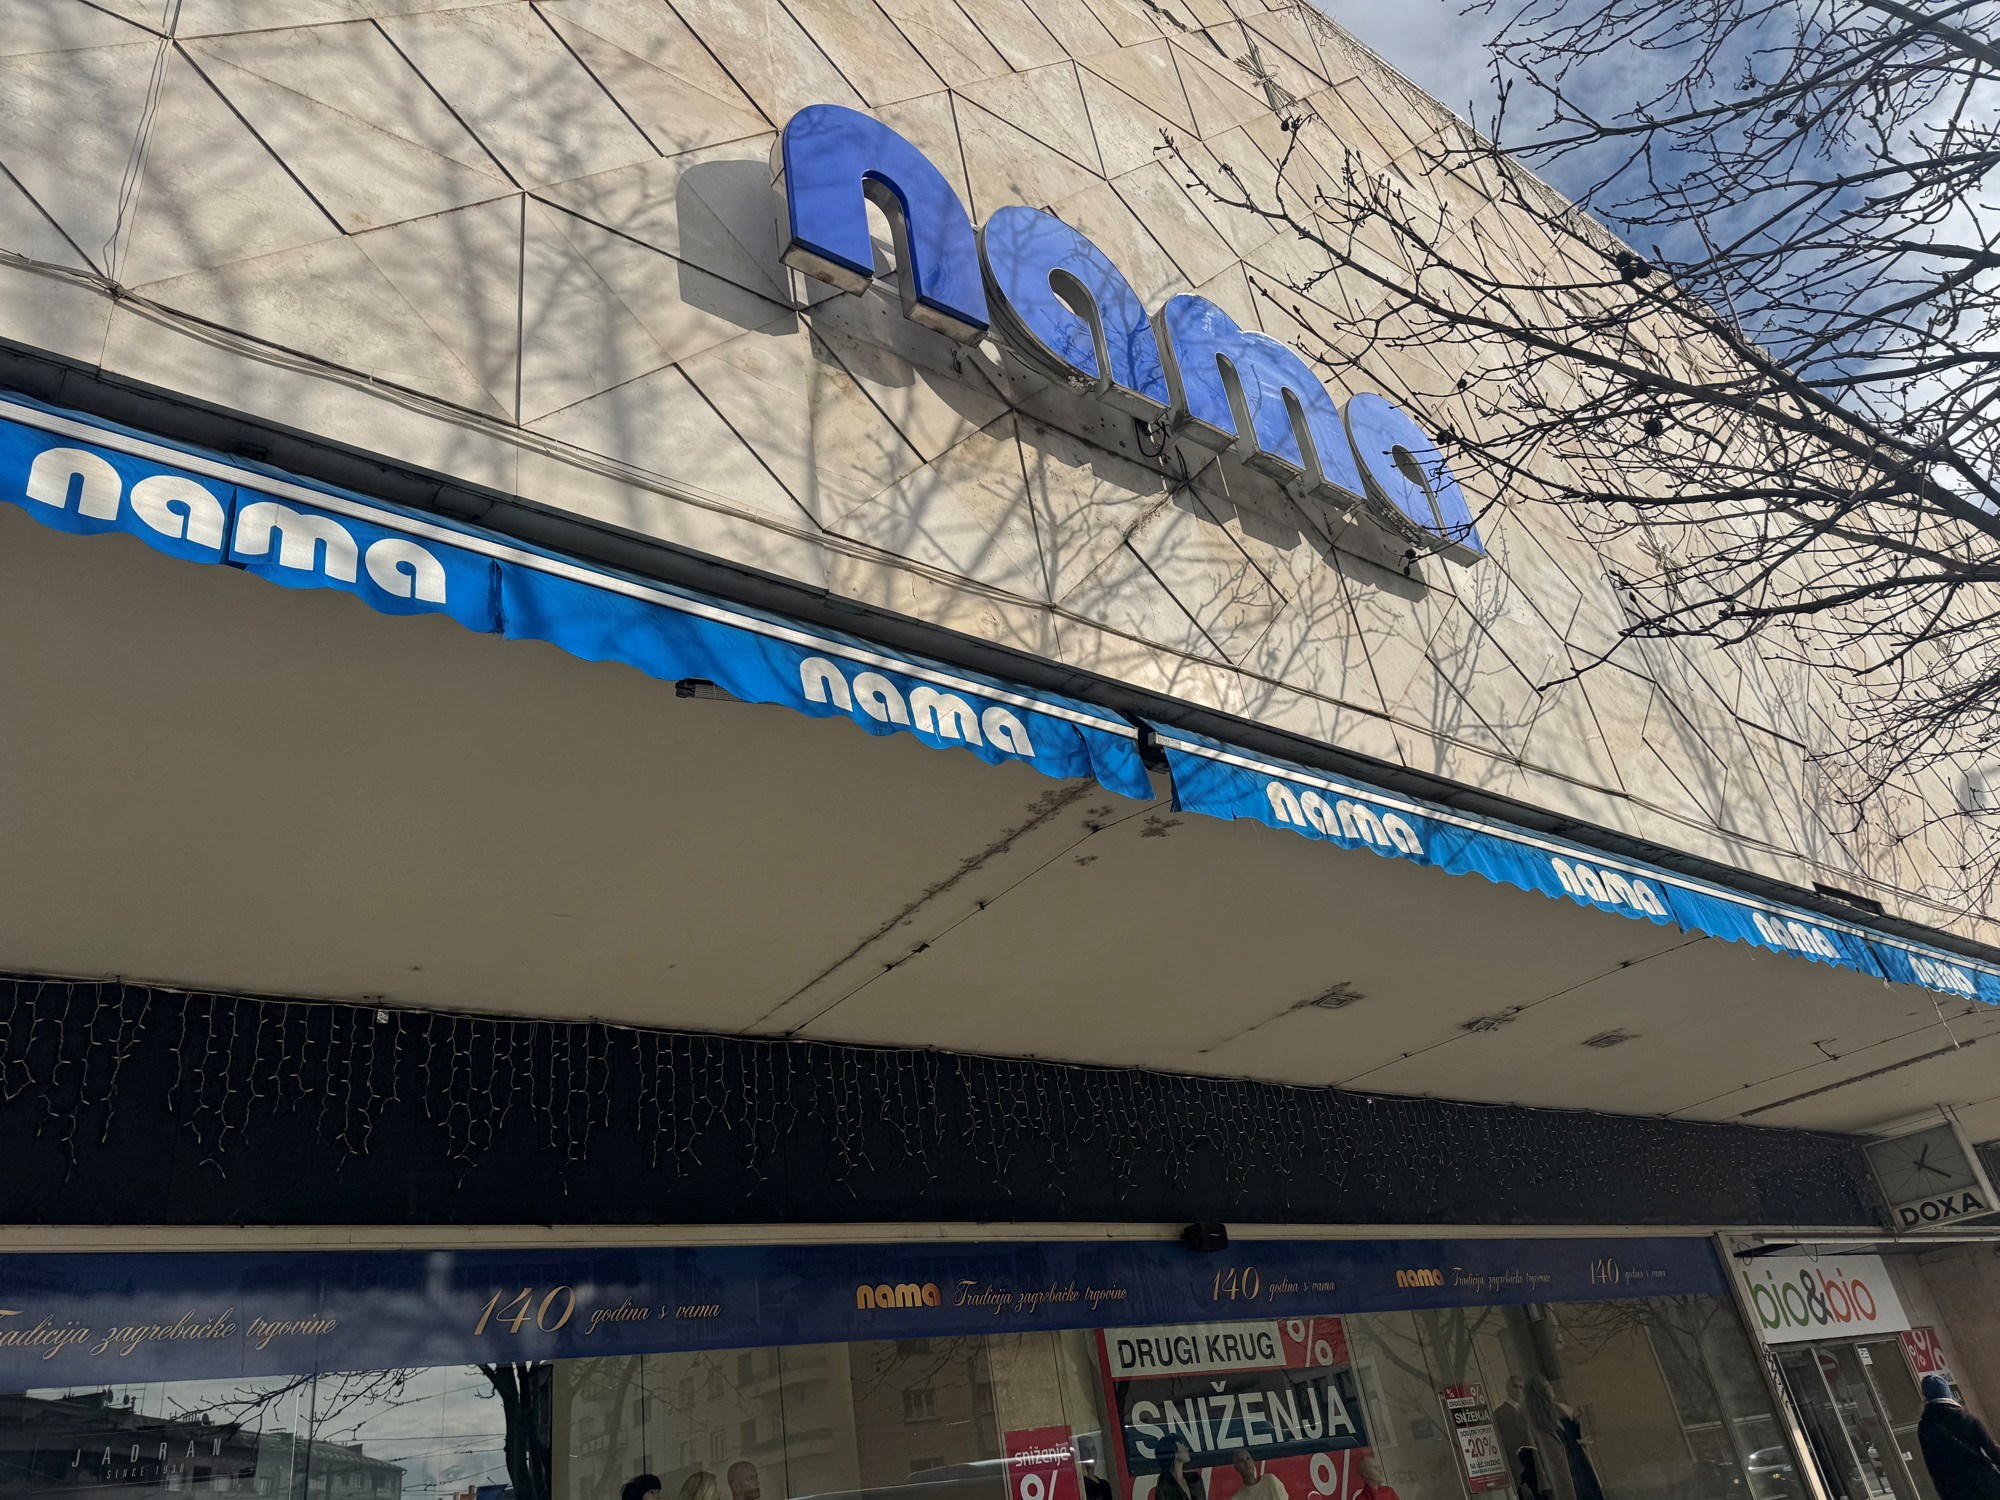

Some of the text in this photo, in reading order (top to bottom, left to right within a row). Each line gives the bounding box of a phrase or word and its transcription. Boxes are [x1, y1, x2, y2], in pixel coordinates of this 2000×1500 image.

[770, 104, 1486, 567] nama
[25, 447, 447, 604] nama
[799, 656, 1035, 757] nama
[1266, 781, 1424, 854] nama
[1551, 857, 1668, 916] nama
[1752, 912, 1842, 959] nama
[1898, 1191, 1984, 1226] DOXA
[1213, 1266, 1260, 1301] 140
[1268, 1275, 1300, 1302] godina
[1303, 1281, 1308, 1292] s
[1395, 1268, 1445, 1288] nama
[1590, 1257, 1620, 1285] 140
[474, 1285, 723, 1335] 140 godina s vama
[856, 1278, 1128, 1315] nama Tradicija zagrebačke trgovine
[1742, 1267, 1877, 1330] bio&bio
[90, 1307, 238, 1356] zagrebačke
[246, 1313, 339, 1350] trgovine
[1116, 1331, 1277, 1369] DRUGI KRUG
[1131, 1380, 1357, 1459] SNIŽENJA
[1454, 1410, 1491, 1424] SNIŽENJA
[72, 1438, 222, 1468] JADRAN
[1014, 1442, 1069, 1467] sniženje
[1464, 1437, 1498, 1458] -20%
[106, 1466, 145, 1479] SINCE
